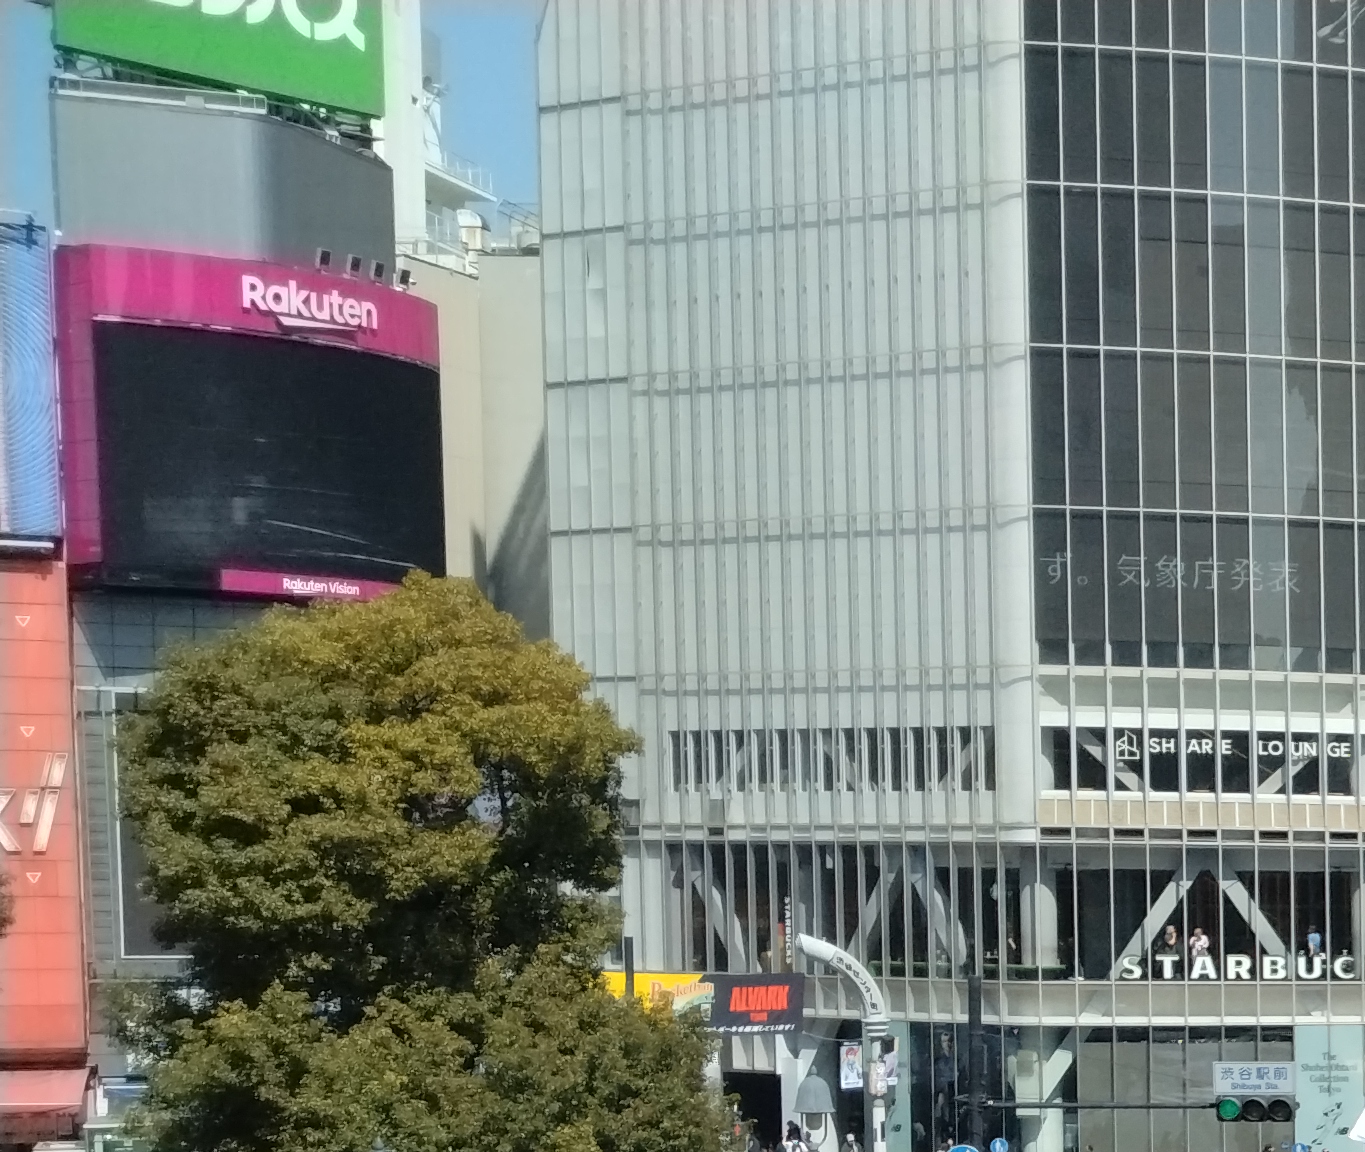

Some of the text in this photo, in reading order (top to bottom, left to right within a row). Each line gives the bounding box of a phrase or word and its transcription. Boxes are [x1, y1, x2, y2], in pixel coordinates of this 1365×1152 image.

[242, 275, 379, 331] Rakuten
[283, 577, 360, 596] Rakuten Vision
[1149, 738, 1351, 757] SHARE LOUNGE
[784, 896, 792, 964] STARBUCKS
[1221, 1066, 1288, 1081] 渋谷駅前
[1230, 1082, 1281, 1092] Shibuya Sta.
